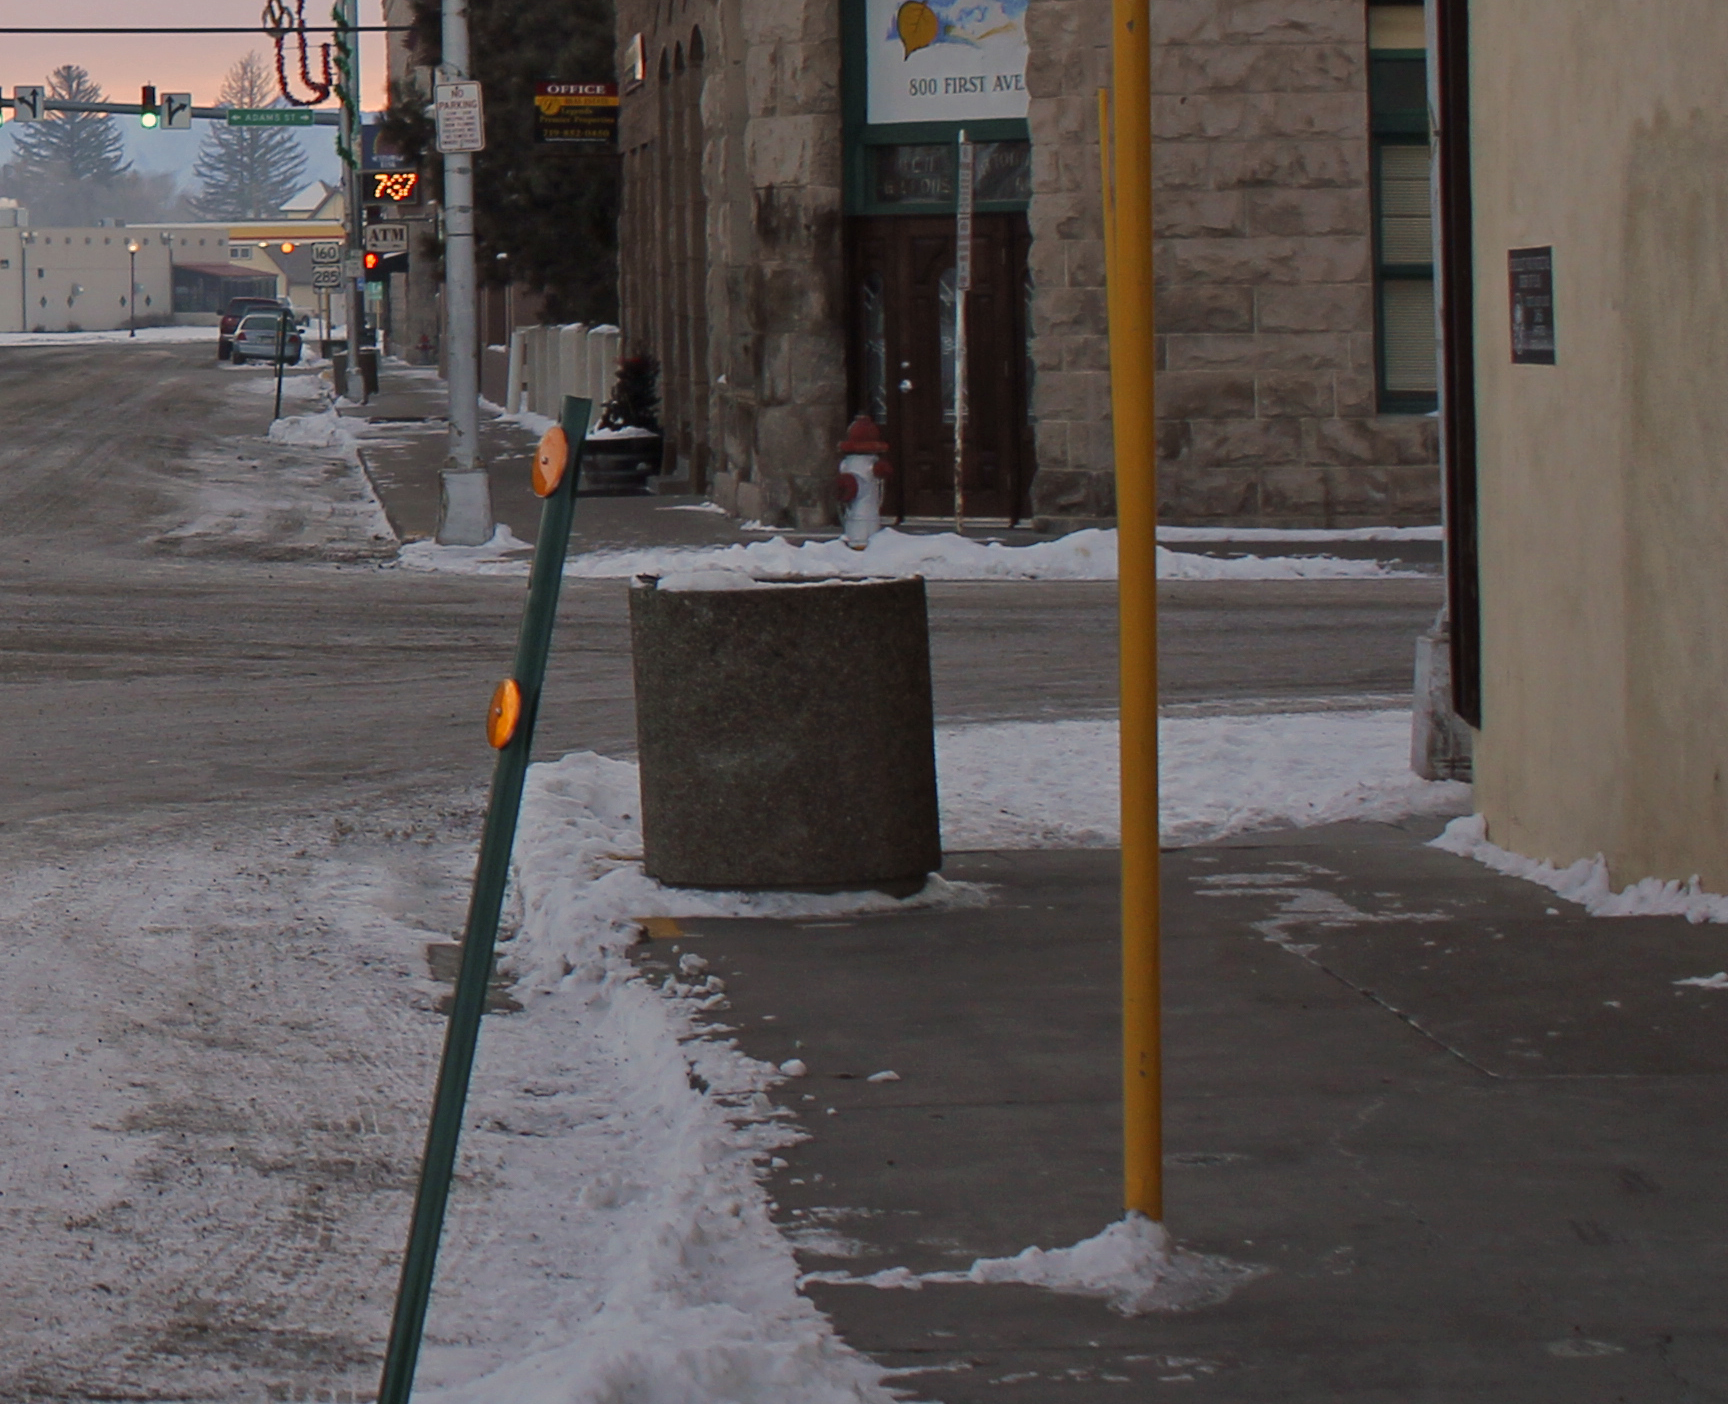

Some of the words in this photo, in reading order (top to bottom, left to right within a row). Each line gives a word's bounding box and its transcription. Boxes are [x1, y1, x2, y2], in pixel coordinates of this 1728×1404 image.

[547, 84, 606, 94] OFFICE
[909, 78, 937, 96] 800
[944, 75, 987, 94] FIRST
[991, 73, 1026, 92] AVE
[451, 89, 464, 98] NO
[437, 99, 478, 110] PARKING
[245, 113, 280, 122] ADAMS
[285, 113, 296, 122] ST
[369, 228, 405, 242] ATM
[315, 247, 337, 259] 160
[314, 271, 339, 283] 285
